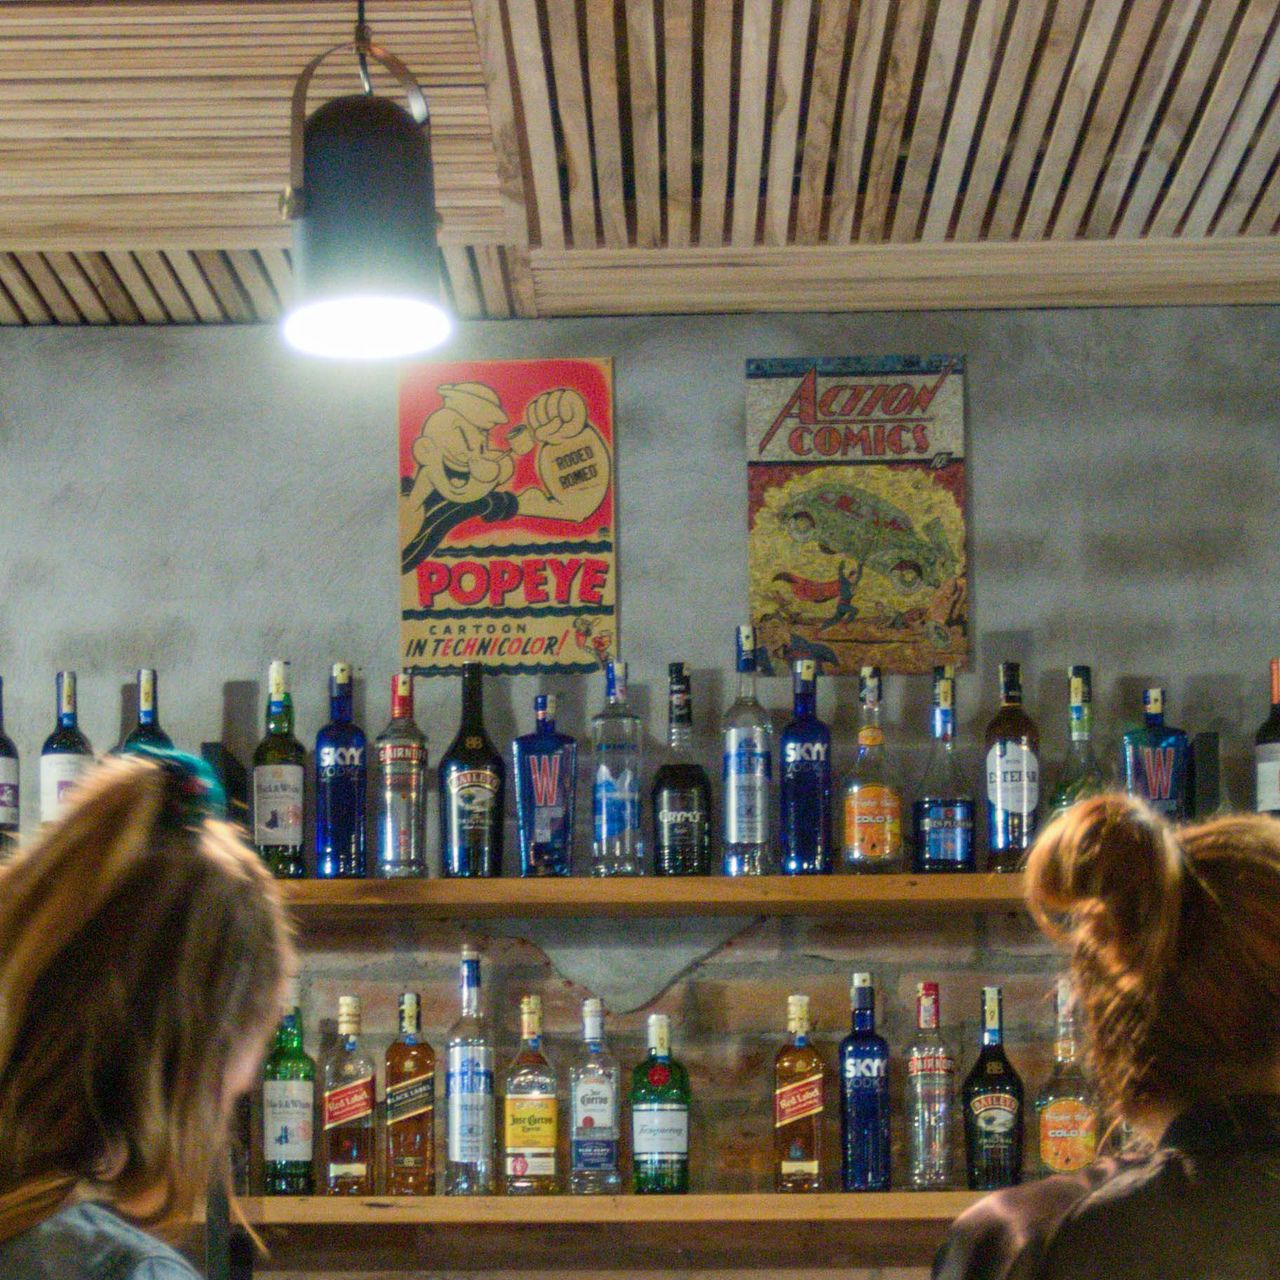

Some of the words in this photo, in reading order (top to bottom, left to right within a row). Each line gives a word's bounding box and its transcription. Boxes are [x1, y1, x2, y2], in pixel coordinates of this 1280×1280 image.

[759, 359, 955, 455] ACTION
[788, 424, 929, 456] COMICS
[416, 558, 609, 608] POPEYE
[406, 639, 428, 657] IN
[432, 629, 569, 657] TECHNICOLOR!
[429, 624, 526, 635] CARTOON
[320, 747, 363, 767] SKYY
[785, 742, 827, 763] SKYY
[529, 755, 560, 806] W
[1144, 746, 1175, 799] W
[845, 1058, 886, 1079] SKYY
[780, 1095, 798, 1109] Red
[798, 1088, 820, 1103] Label
